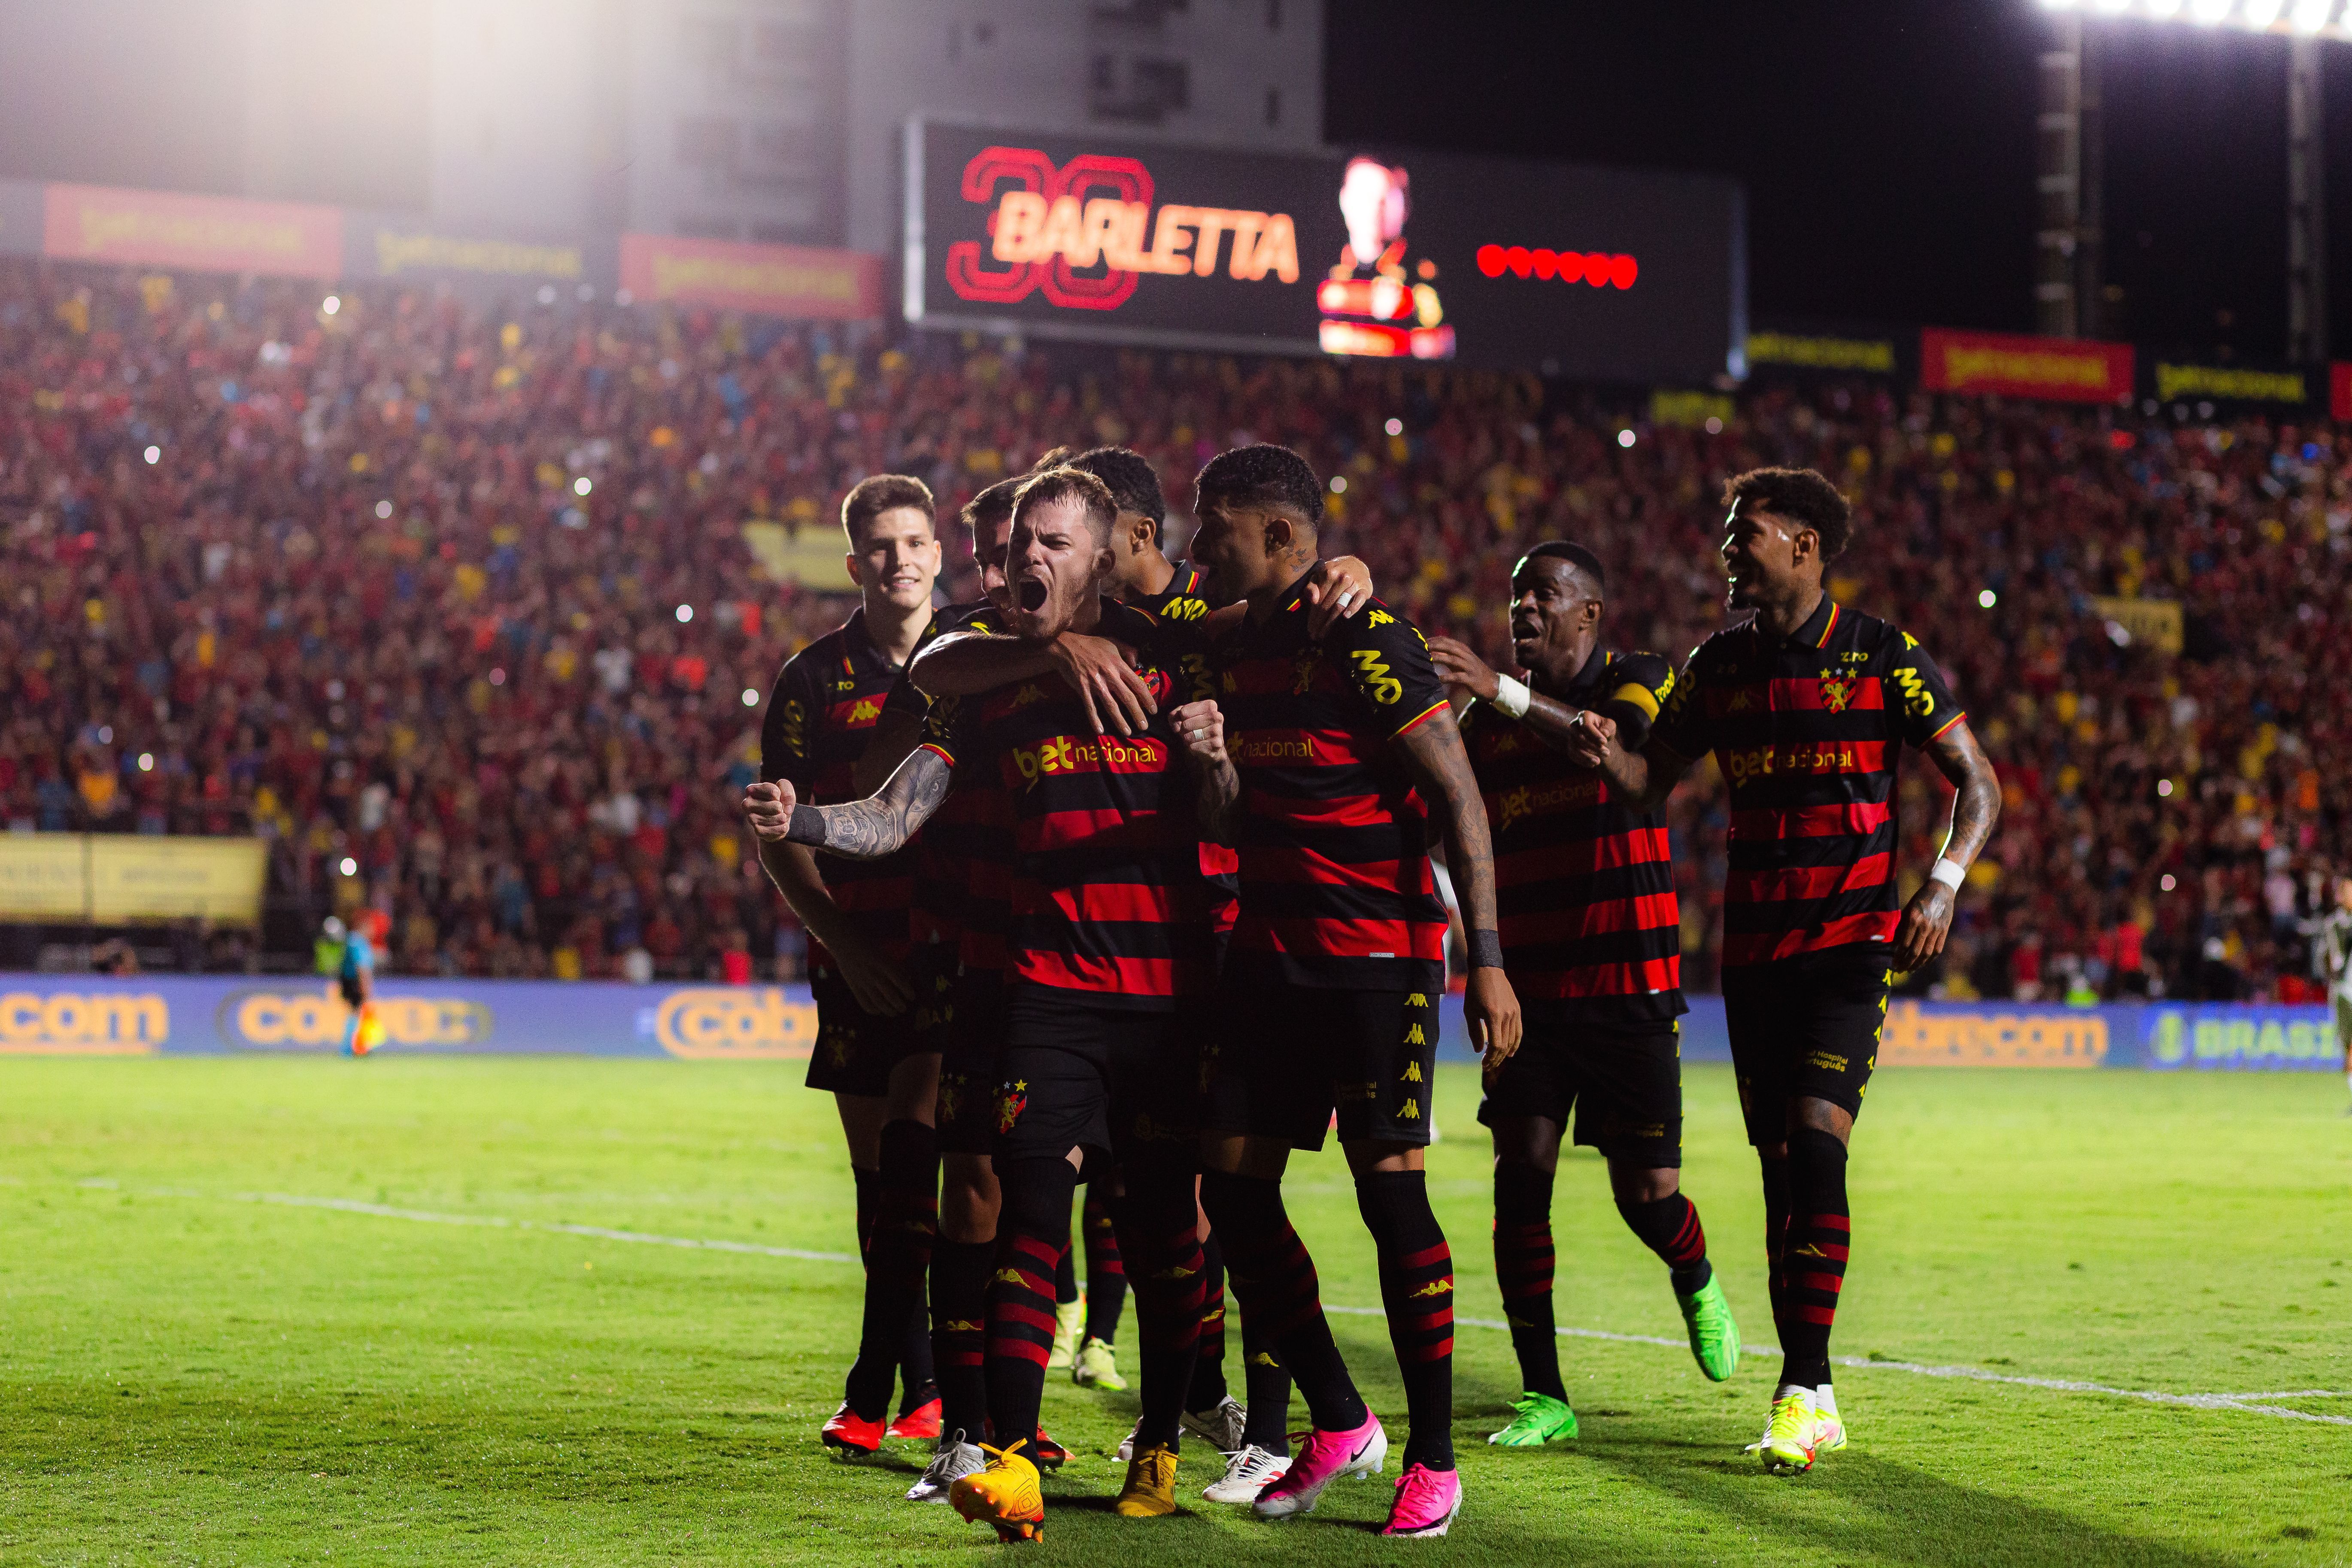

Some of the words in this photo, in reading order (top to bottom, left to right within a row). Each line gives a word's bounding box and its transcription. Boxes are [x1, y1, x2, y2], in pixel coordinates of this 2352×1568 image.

[992, 191, 1299, 283] BARLETTA
[1225, 731, 1314, 764] etnacional
[1805, 1058, 1846, 1072] ortuguês
